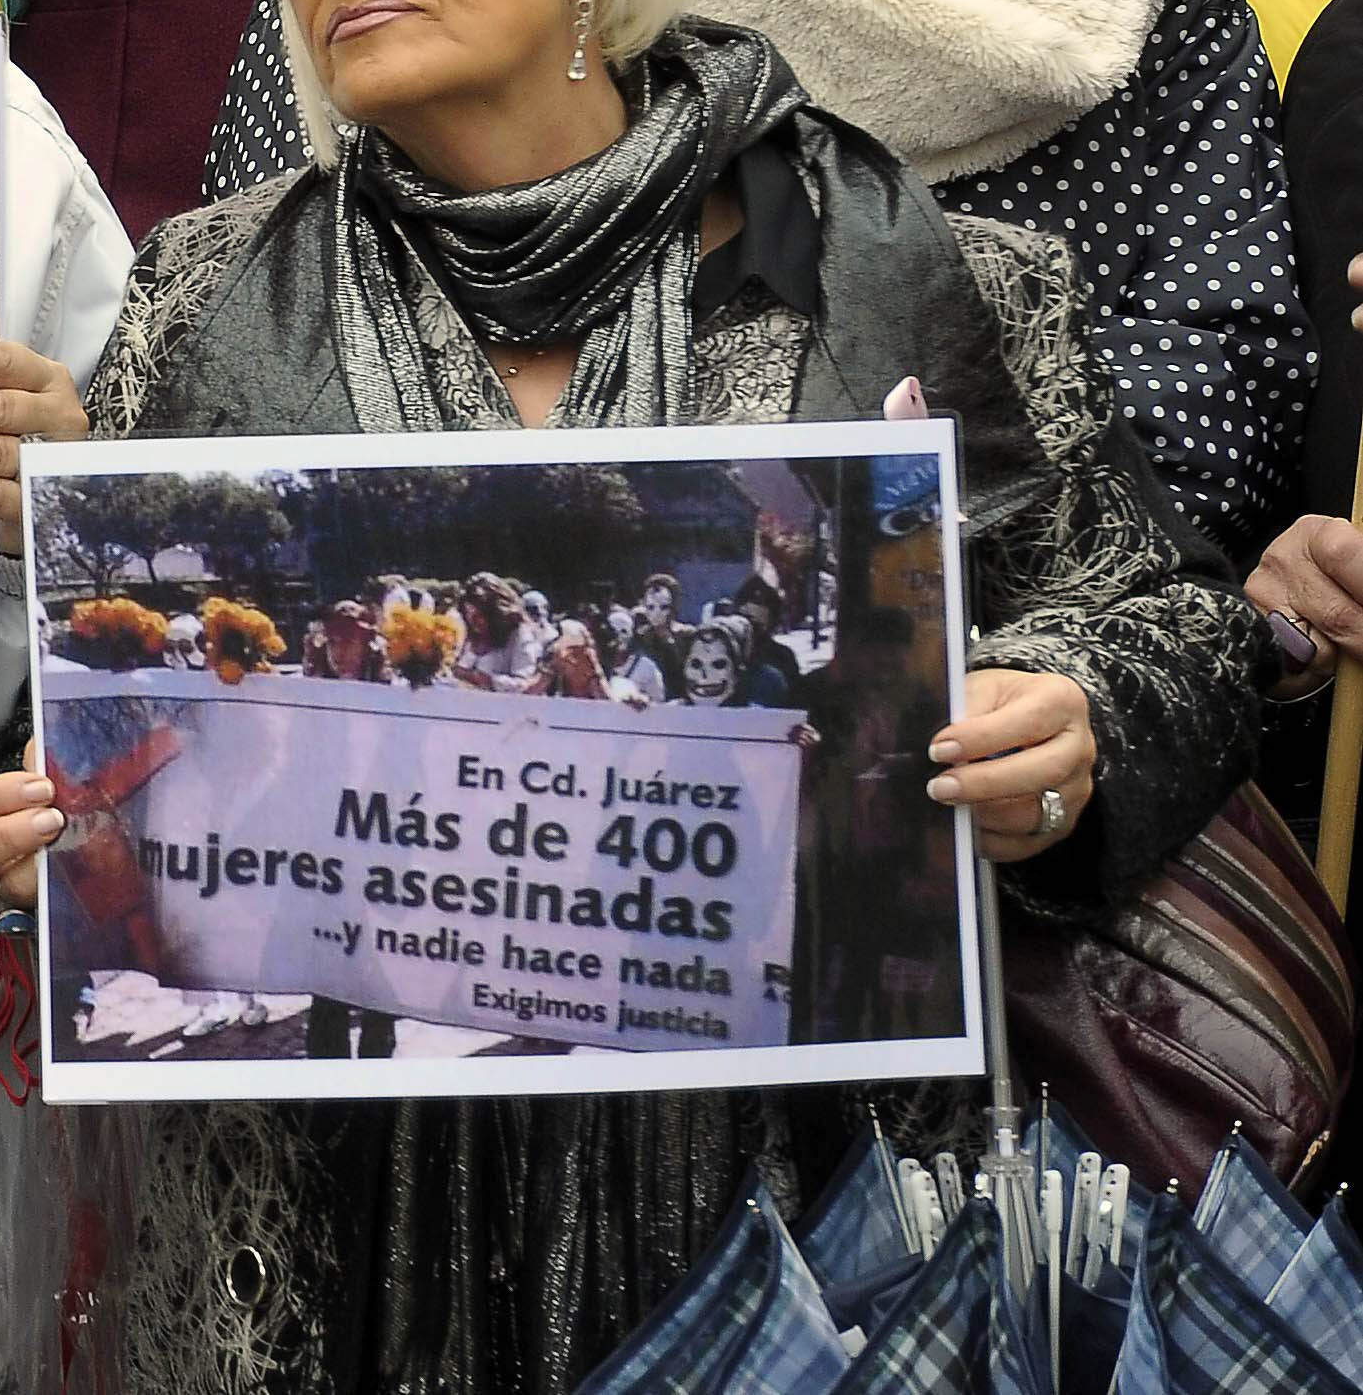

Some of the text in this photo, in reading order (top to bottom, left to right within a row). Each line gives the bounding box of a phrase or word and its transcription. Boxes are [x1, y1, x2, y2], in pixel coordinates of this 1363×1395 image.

[459, 757, 739, 808] En Cd. Juárez
[336, 790, 737, 876] Más de 400
[139, 834, 733, 941] mujeres asesinadas
[376, 923, 483, 964] nadie
[503, 939, 602, 978] hace
[620, 949, 730, 993] nada
[475, 984, 727, 1039] Exigimos justicia
